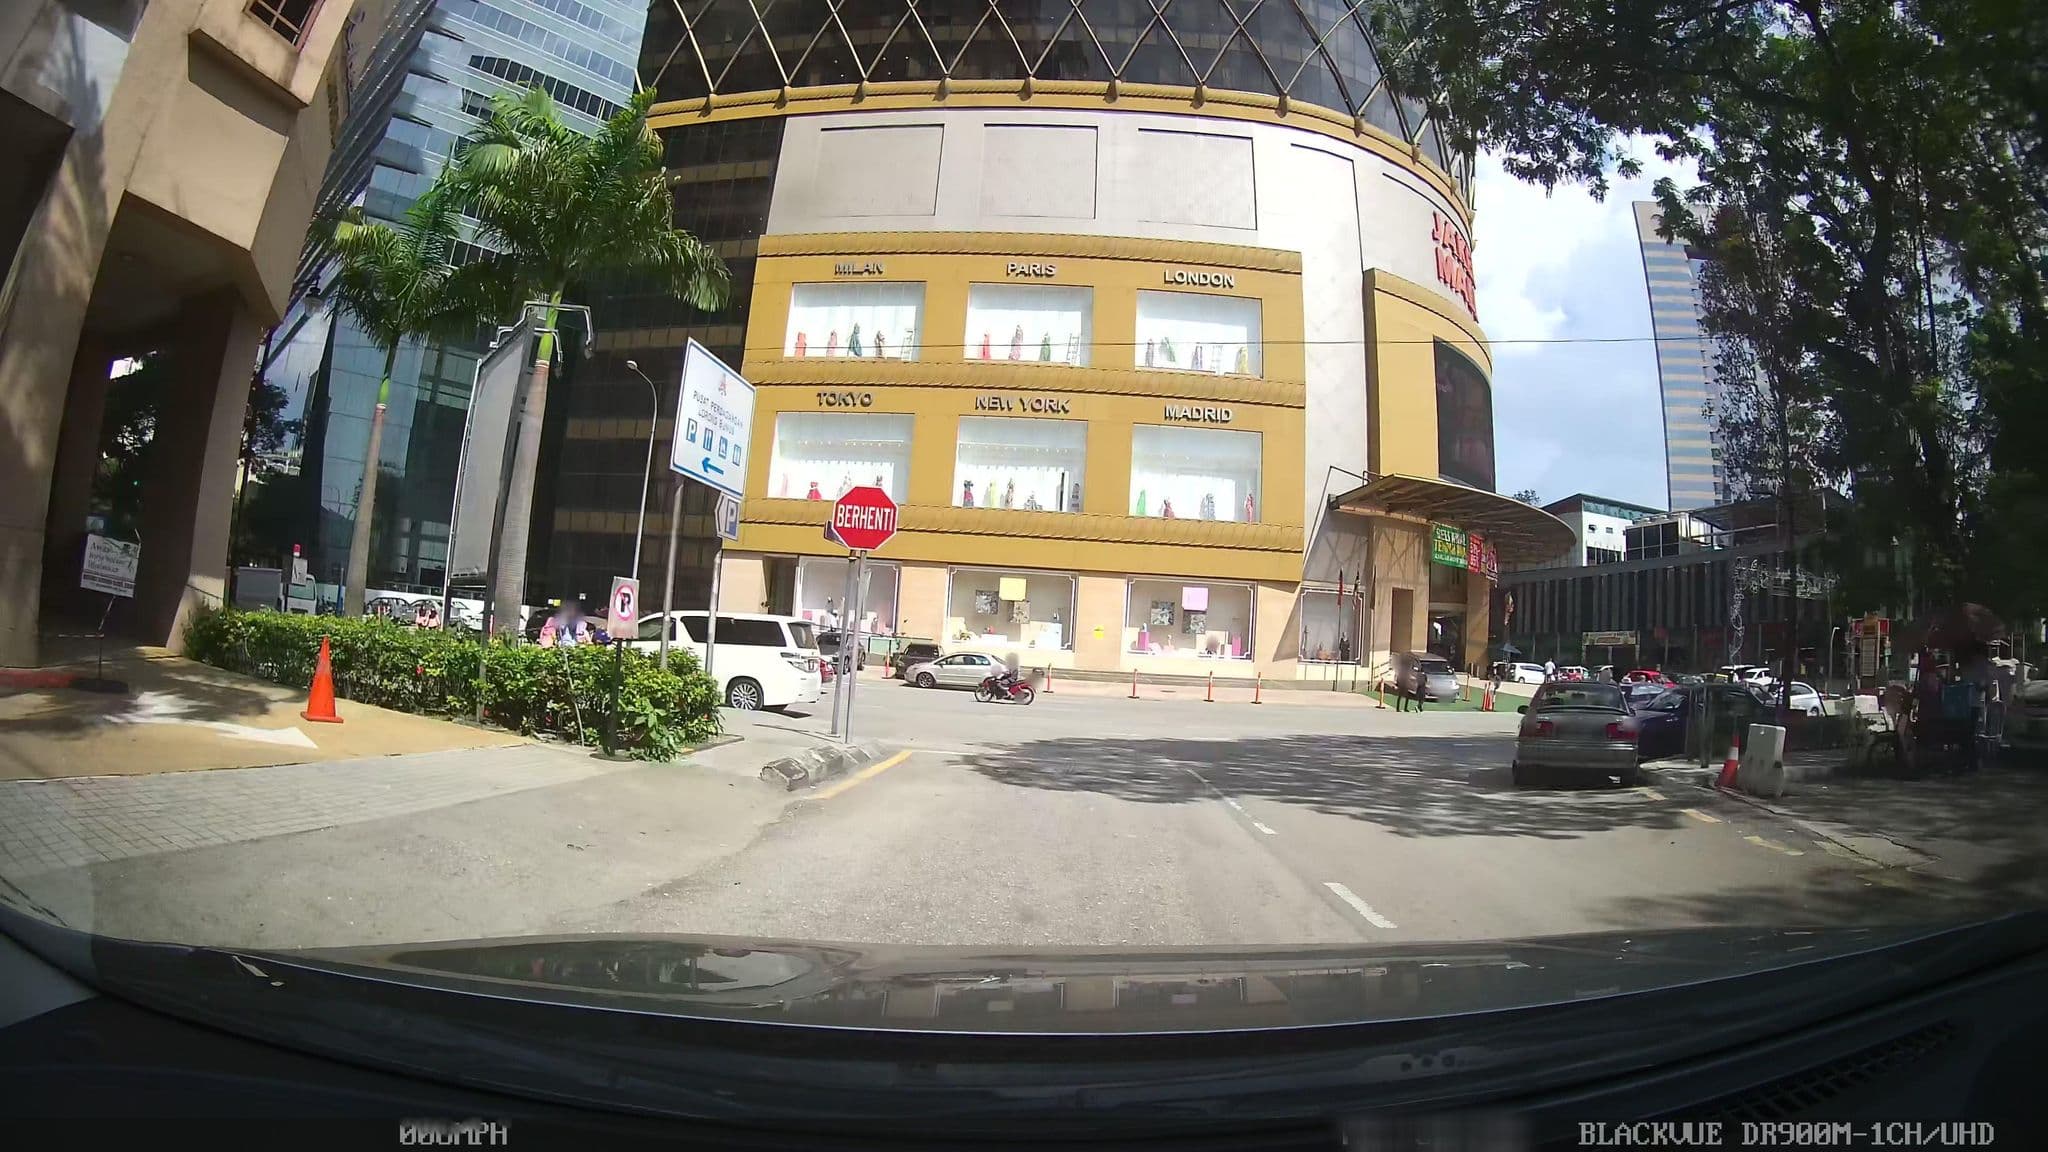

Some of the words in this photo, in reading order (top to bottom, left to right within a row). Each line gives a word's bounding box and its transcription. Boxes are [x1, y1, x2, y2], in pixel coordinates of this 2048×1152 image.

[834, 262, 884, 276] MILAN
[1006, 262, 1056, 278] PARIS
[1164, 269, 1235, 289] LONDON
[816, 391, 873, 408] TOKYO
[975, 396, 1013, 412] NEW
[1018, 397, 1071, 414] YORK
[1164, 404, 1233, 424] MADRID
[836, 504, 894, 531] BERHENTI
